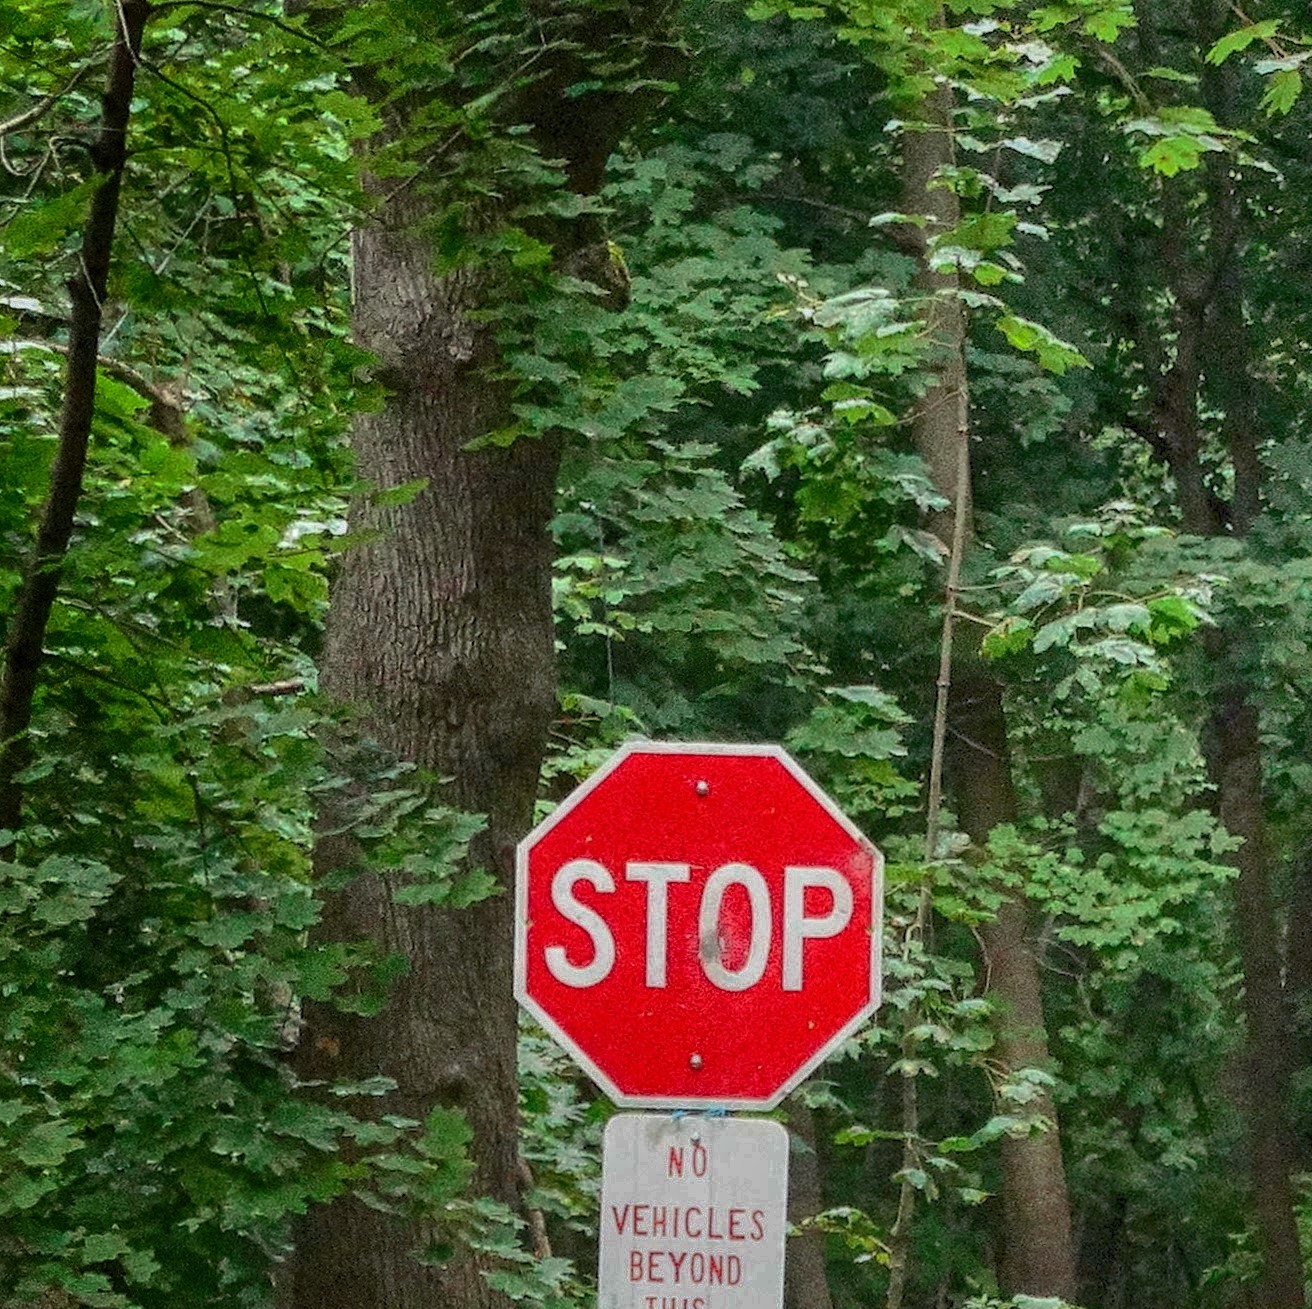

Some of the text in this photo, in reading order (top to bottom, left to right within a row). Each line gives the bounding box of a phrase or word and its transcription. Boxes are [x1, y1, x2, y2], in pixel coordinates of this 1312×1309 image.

[543, 858, 854, 992] STOP
[668, 1146, 708, 1177] NO
[612, 1205, 765, 1241] VEHICLES
[630, 1251, 741, 1286] BEYOND
